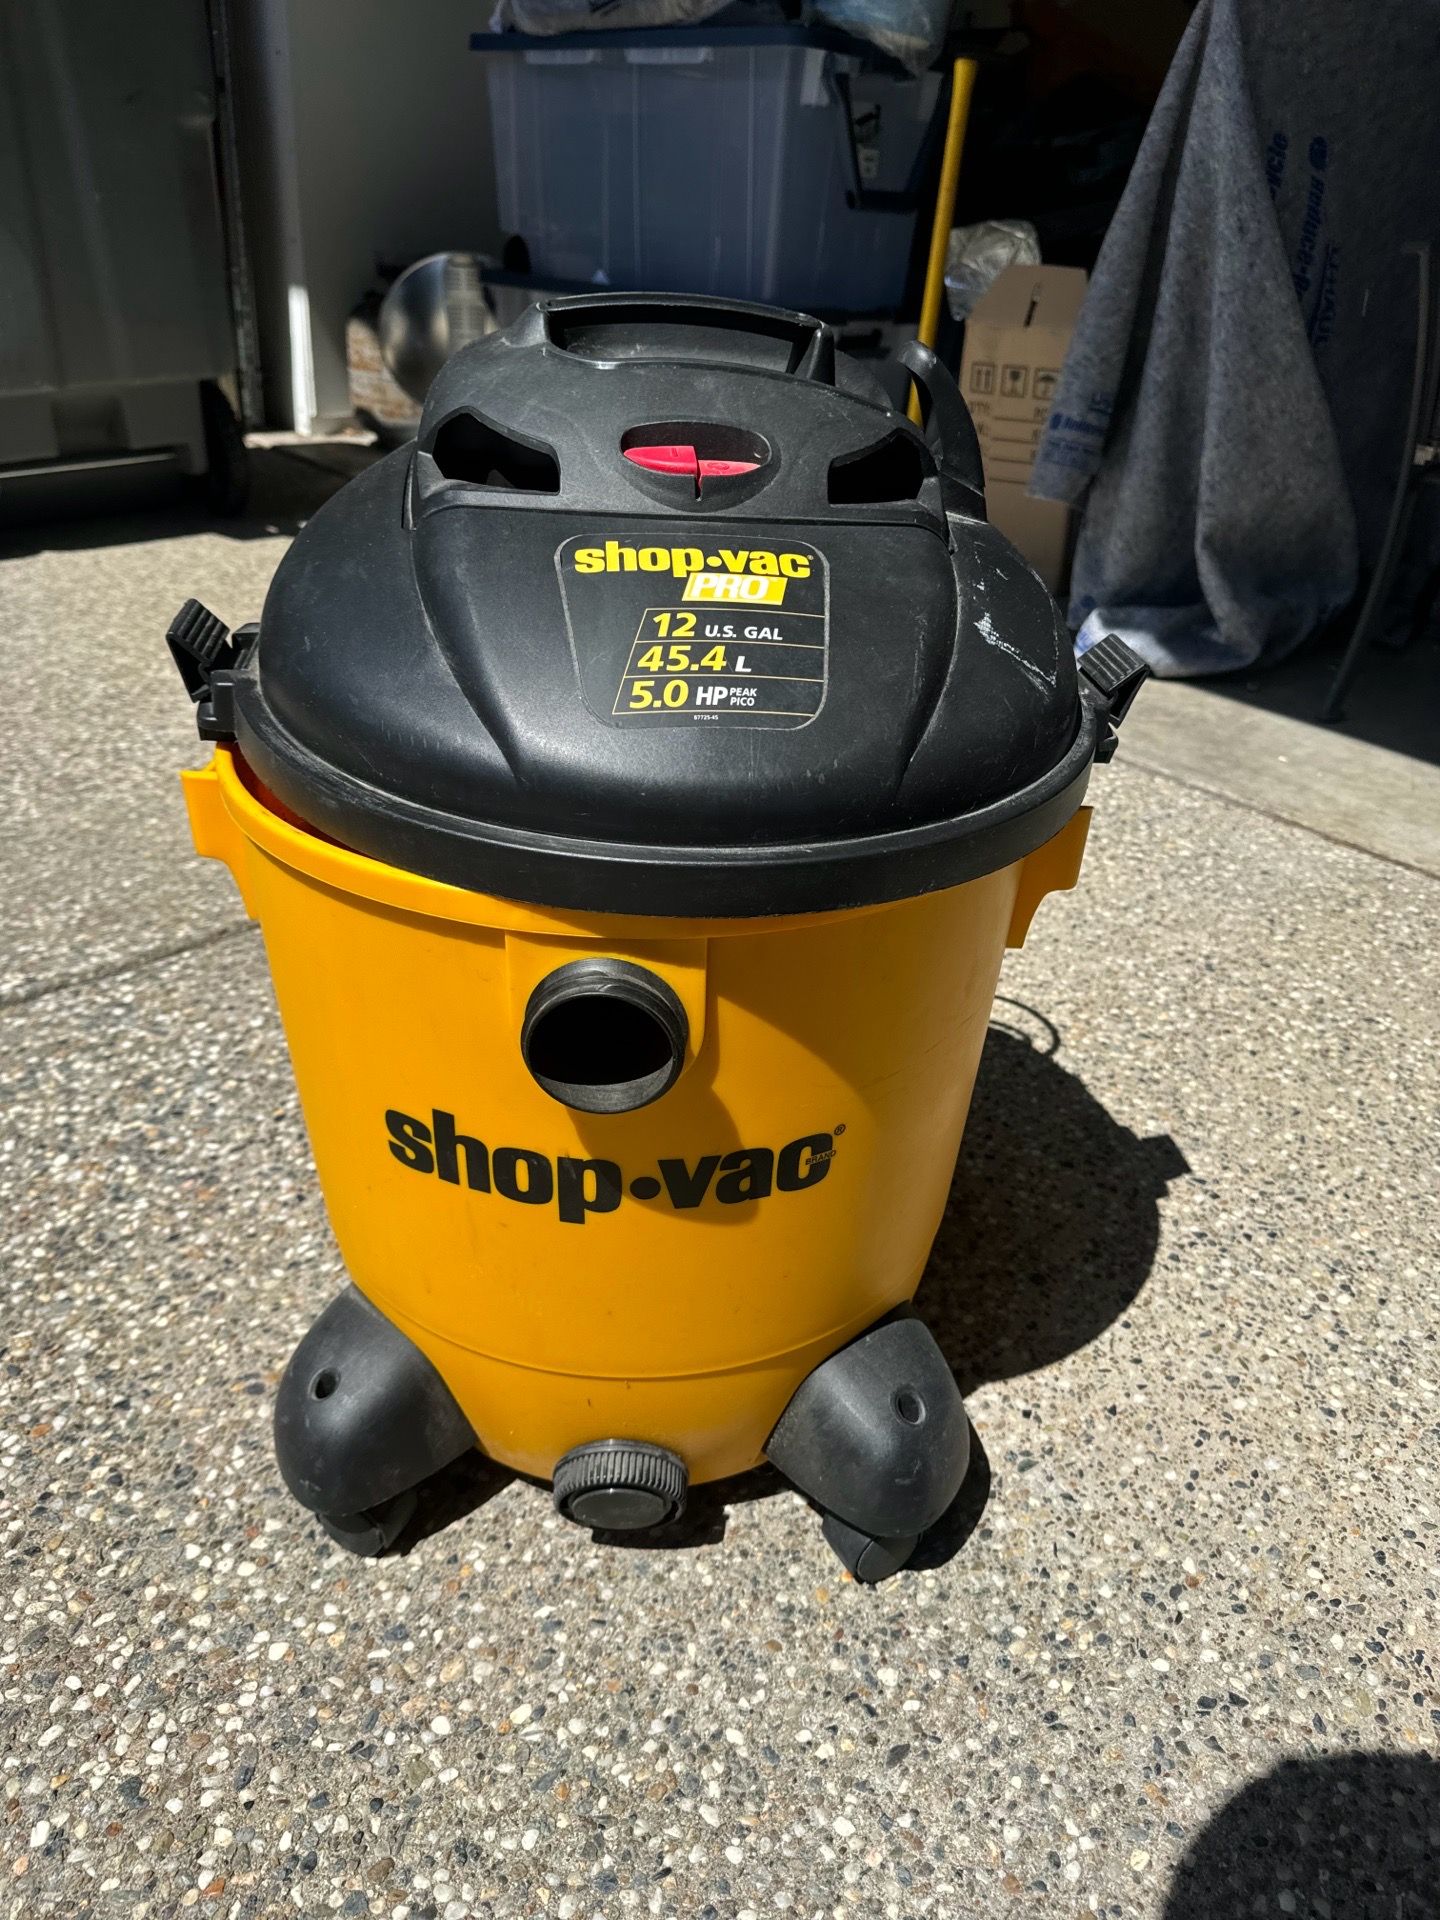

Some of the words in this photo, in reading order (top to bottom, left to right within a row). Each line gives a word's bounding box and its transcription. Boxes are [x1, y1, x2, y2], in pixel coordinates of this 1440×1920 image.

[690, 574, 769, 600] PRO
[652, 612, 697, 637] 12
[704, 624, 737, 638] U.S.
[744, 626, 783, 640] GAL
[637, 645, 727, 672] 45.4
[735, 656, 752, 672] L
[629, 679, 689, 709] 5.0
[695, 686, 728, 706] HP
[729, 687, 757, 697] PEAK
[730, 697, 755, 707] PICO
